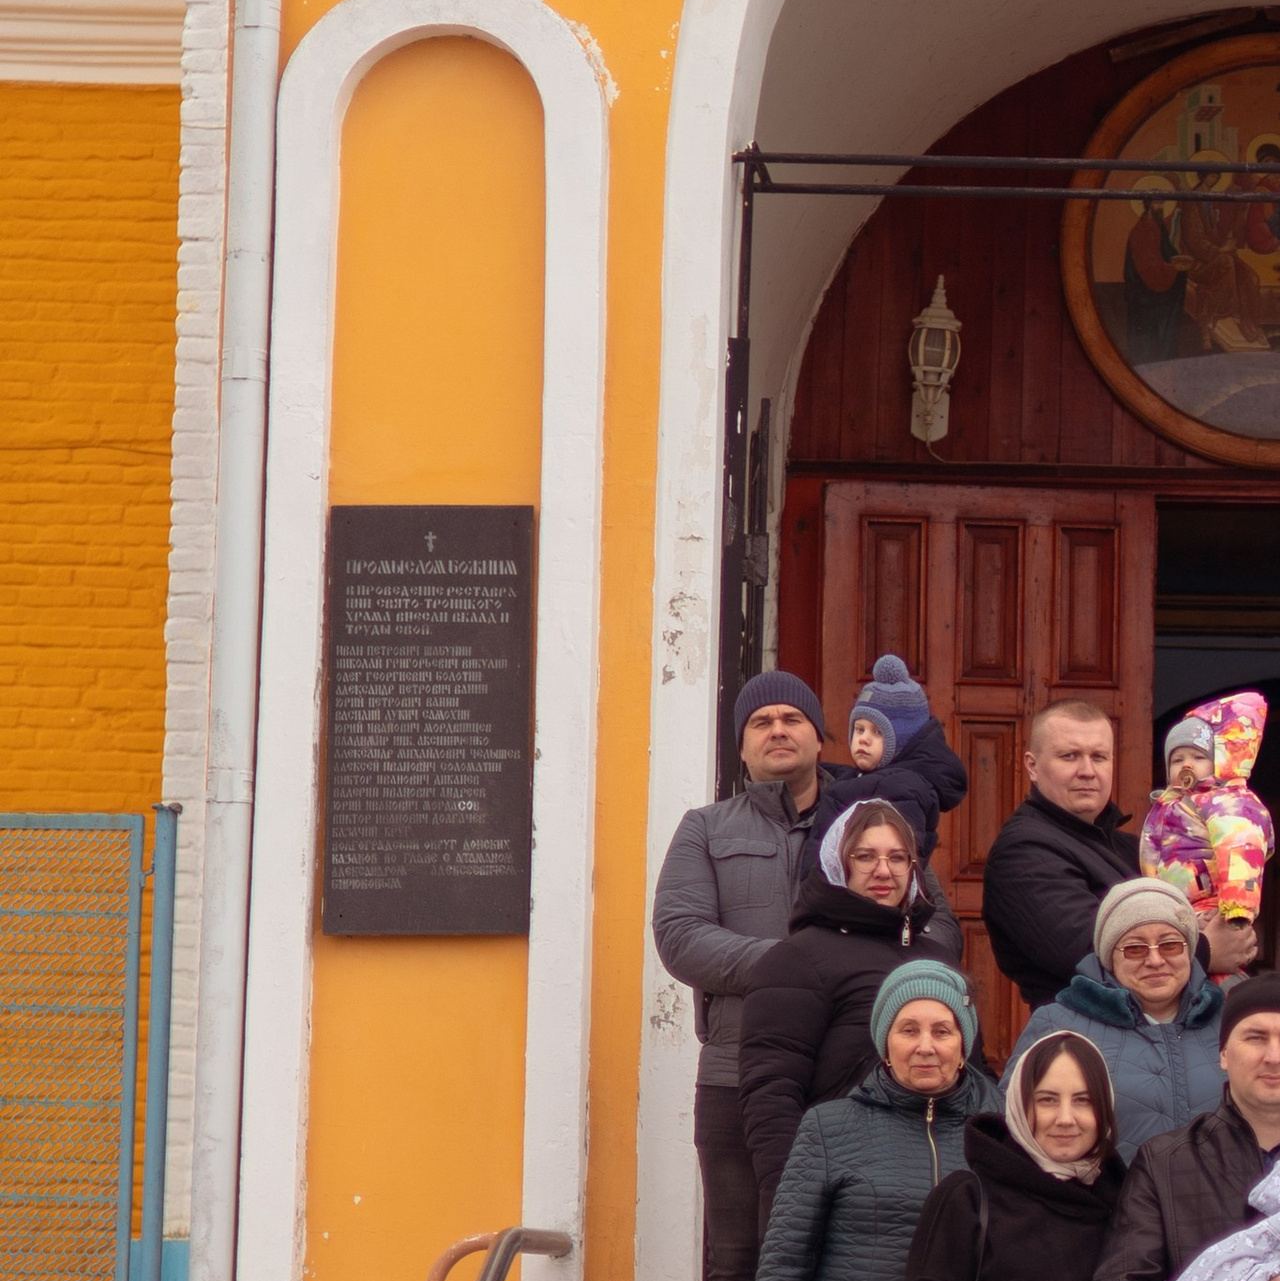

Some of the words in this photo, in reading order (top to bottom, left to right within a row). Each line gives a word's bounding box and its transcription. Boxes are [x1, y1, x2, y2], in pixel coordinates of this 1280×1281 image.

[346, 560, 446, 574] ПРОМЫСЛОМ
[345, 586, 355, 595] В
[345, 611, 391, 622] ХРАМА
[396, 612, 448, 623] ВНЕСЛИ
[452, 612, 496, 624] ВКЛАД
[500, 612, 509, 623] И
[345, 625, 391, 637] ТРУДЫ
[336, 646, 363, 656] ИВАН
[367, 646, 419, 656] ПЕТРОВИЧ
[336, 672, 362, 682] ОЛЕГ
[335, 684, 394, 695] АЛЕКСАНДР
[399, 684, 451, 694] ПЕТРОВИЧ
[368, 697, 421, 707] ПЕТРОВИЧ
